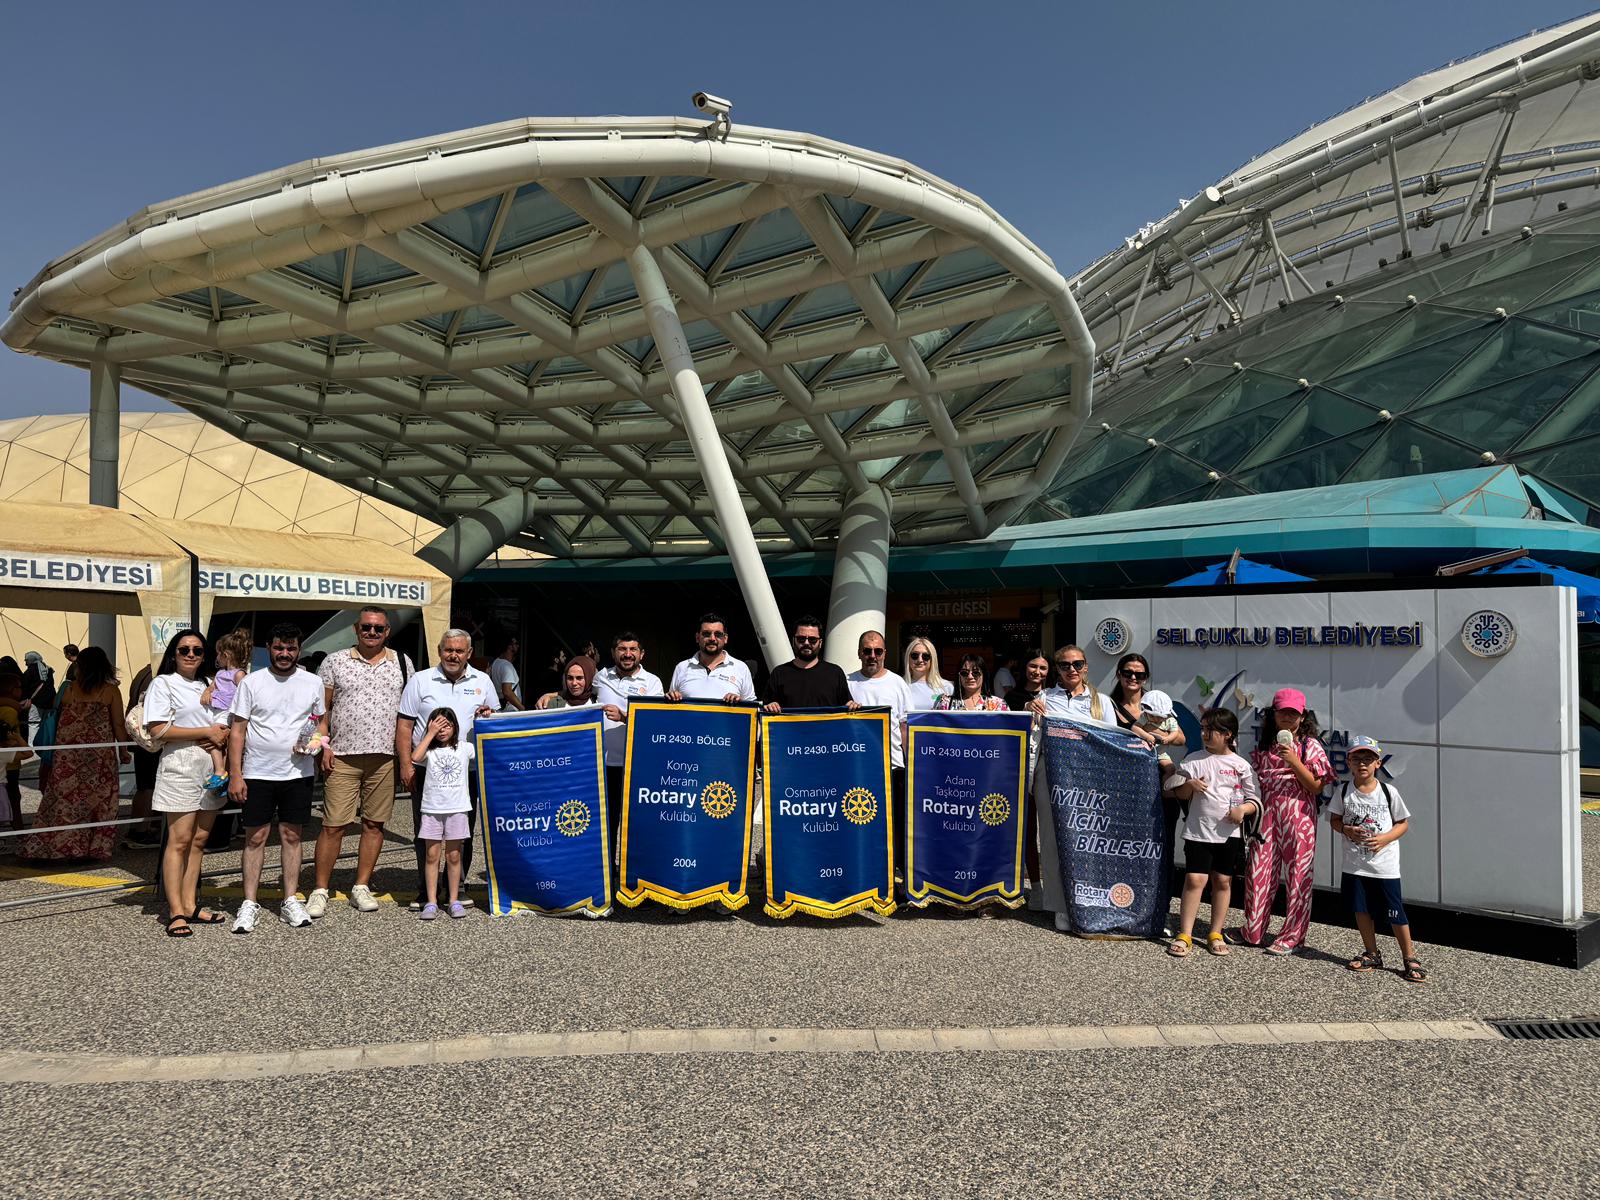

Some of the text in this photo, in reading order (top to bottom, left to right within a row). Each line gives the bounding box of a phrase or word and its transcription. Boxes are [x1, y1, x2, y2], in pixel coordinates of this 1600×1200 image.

[199, 571, 425, 600] SELÇUKLU BELEDİYESİ
[919, 598, 991, 618] BİLET GİŞESİ
[1156, 622, 1422, 649] SELÇUKLU BELEDİYESİ
[651, 734, 731, 746] UR 2430. BÖLGE
[787, 742, 866, 755] UR 2430. BÖLGE
[921, 746, 1000, 758] UR 2430 BÖLGE
[509, 757, 572, 771] 2430. BÖLGE
[667, 760, 699, 773] Konya
[660, 776, 698, 787] Meram
[945, 775, 976, 786] Adana
[638, 788, 697, 808] Rotary
[784, 787, 837, 799] Osmaniye
[935, 786, 976, 800] Taşköprü
[1051, 785, 1110, 810] İYİLİK
[514, 800, 552, 814] Kayseri
[779, 800, 838, 818] Rotary
[923, 799, 975, 819] Rotary
[660, 811, 697, 823] Kulübü
[1067, 807, 1110, 832] İÇİN
[495, 816, 551, 832] Rotary
[802, 821, 839, 833] Kulübü
[942, 820, 976, 832] Kulübü
[516, 835, 553, 848] Kulübü
[1075, 833, 1163, 860] BİRLEŞİN
[673, 858, 697, 868] 2004
[820, 868, 843, 878] 2019
[954, 871, 977, 880] 2019
[536, 880, 557, 890] 1986
[1075, 884, 1109, 899] Rotary
